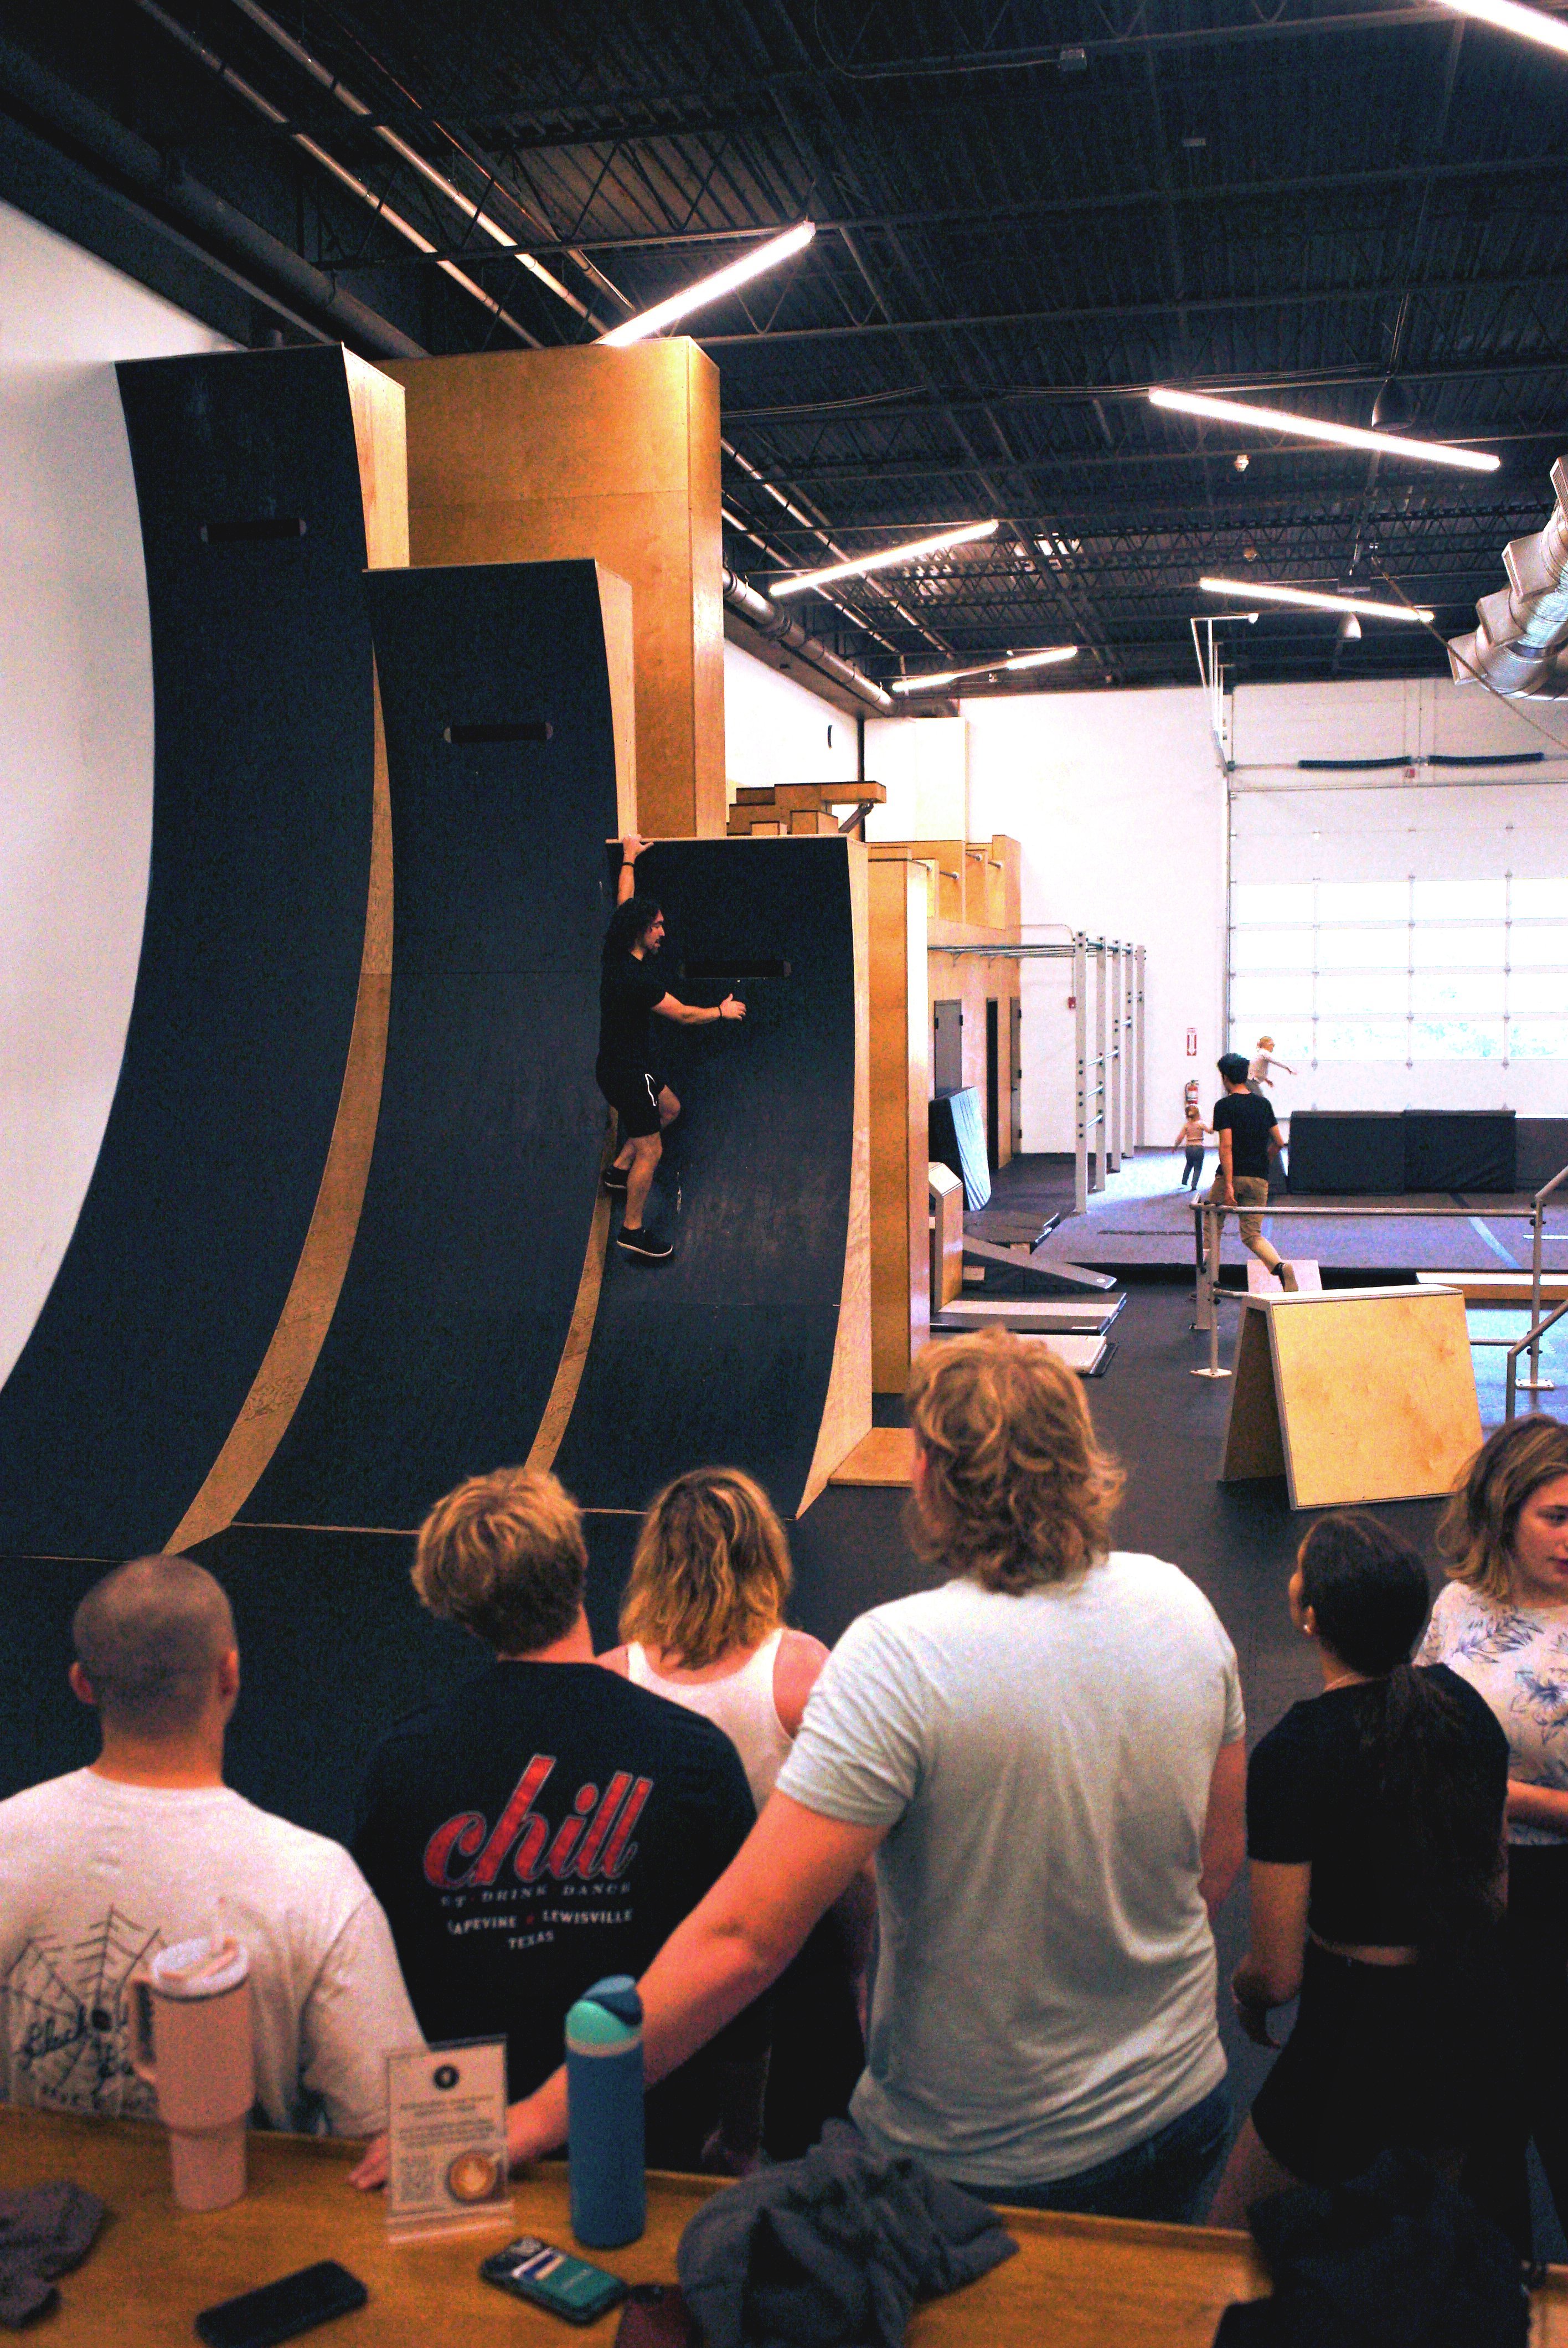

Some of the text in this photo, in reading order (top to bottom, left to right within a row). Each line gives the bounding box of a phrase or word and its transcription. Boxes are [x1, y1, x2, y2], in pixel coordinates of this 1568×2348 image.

[423, 1753, 654, 1889] chill
[482, 1884, 547, 1903] DRINK
[561, 1882, 631, 1896] DANCE
[447, 1909, 633, 1935] APEVINE LEWISVILLE
[508, 1929, 554, 1949] TEXAS
